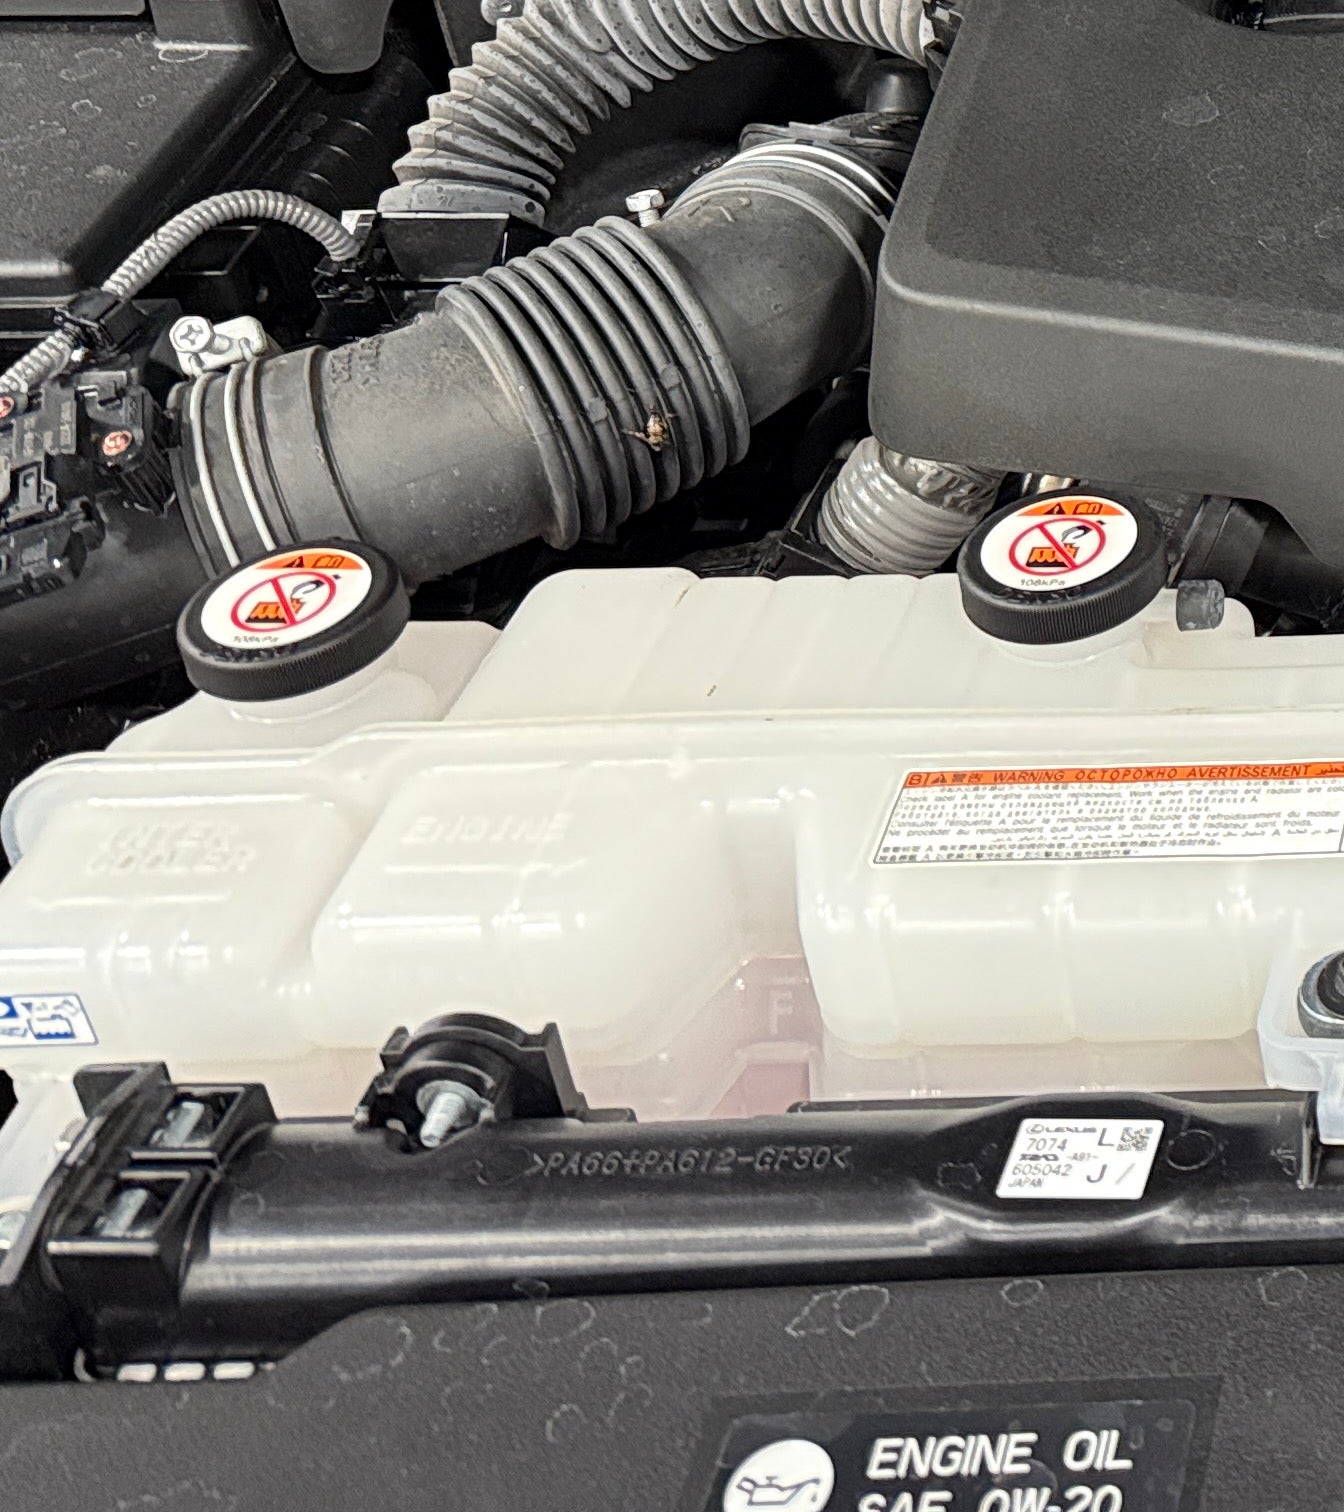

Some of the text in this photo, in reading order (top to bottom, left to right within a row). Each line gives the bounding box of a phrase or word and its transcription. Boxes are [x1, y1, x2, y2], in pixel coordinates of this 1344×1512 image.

[993, 770, 1065, 783] WARNING
[1186, 764, 1312, 778] AVERTISSEMENT
[1098, 1127, 1115, 1147] L
[1027, 1137, 1068, 1152] 7074
[1011, 1163, 1073, 1177] 605042
[1086, 1163, 1108, 1184] J
[1008, 1177, 1045, 1188] JAPAN
[866, 1429, 1133, 1480] ENGINE OIL
